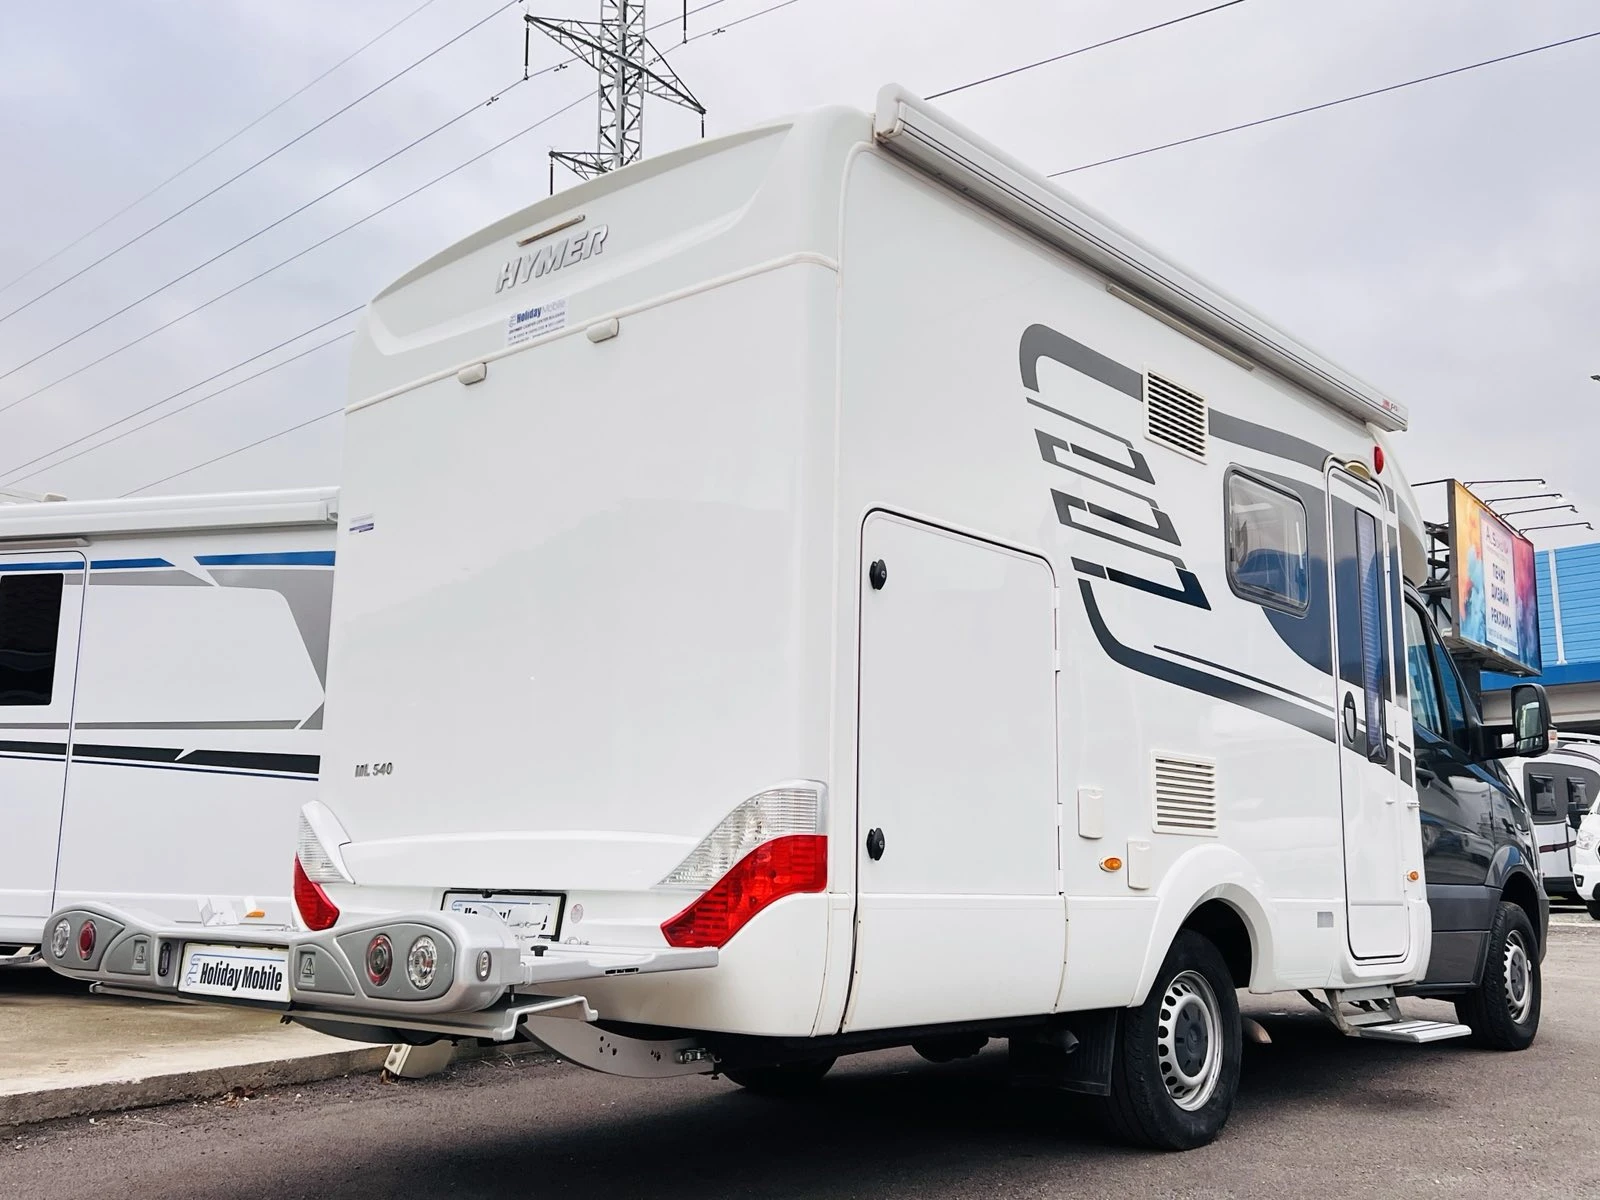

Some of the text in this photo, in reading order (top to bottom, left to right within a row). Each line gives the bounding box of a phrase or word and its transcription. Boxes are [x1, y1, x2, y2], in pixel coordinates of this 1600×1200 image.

[495, 224, 608, 294] HYMER
[372, 761, 393, 776] 540
[199, 960, 283, 992] Holiday Mobile
